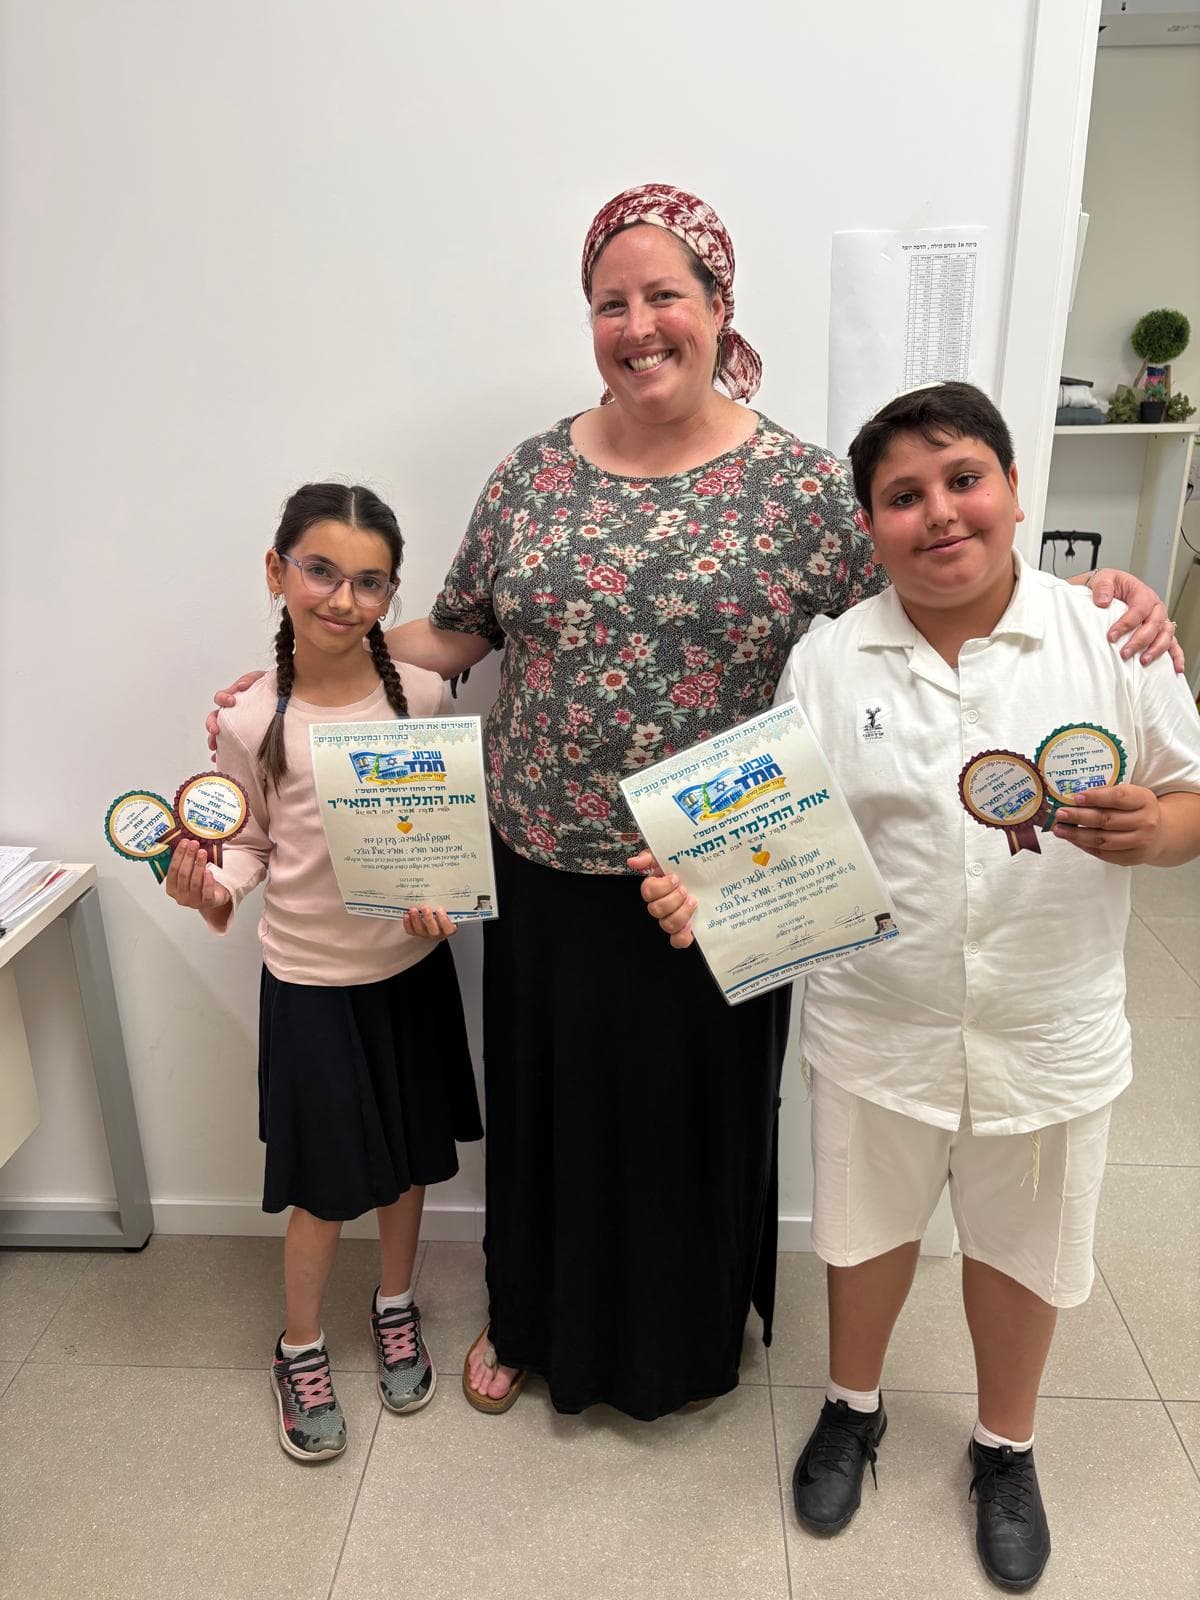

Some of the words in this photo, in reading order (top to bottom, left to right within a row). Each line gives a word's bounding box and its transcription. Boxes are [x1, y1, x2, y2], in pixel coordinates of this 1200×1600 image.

[742, 725, 757, 736] את
[712, 732, 741, 749] העולם
[412, 750, 442, 760] שבוע
[700, 749, 729, 766] בתורה
[404, 760, 446, 772] חמד
[738, 753, 772, 774] שבוע
[1070, 758, 1088, 766] אות
[1080, 762, 1113, 774] התלמיד
[659, 762, 700, 785] ובמעשים
[733, 763, 782, 794] חמד
[1046, 768, 1078, 778] המאי"ר
[992, 780, 1007, 793] אות
[1003, 775, 1032, 795] התלמיד
[1085, 780, 1106, 788] חמד
[328, 797, 380, 808] המאי"ר
[386, 794, 444, 806] התלמיד
[448, 794, 476, 806] אות
[769, 791, 791, 804] חמ"ד
[796, 788, 829, 812] אות
[1016, 790, 1036, 805] חמד
[208, 800, 222, 809] אות
[750, 801, 769, 814] מחוז
[142, 810, 165, 830] התלמיד
[211, 809, 236, 824] התלמיד
[718, 810, 749, 828] ירושלים
[728, 805, 794, 839] התלמיד
[132, 818, 145, 830] אות
[208, 821, 225, 832] חמד
[668, 835, 726, 864] המאי"ר
[815, 857, 836, 874] מבית
[797, 867, 815, 879] ספר
